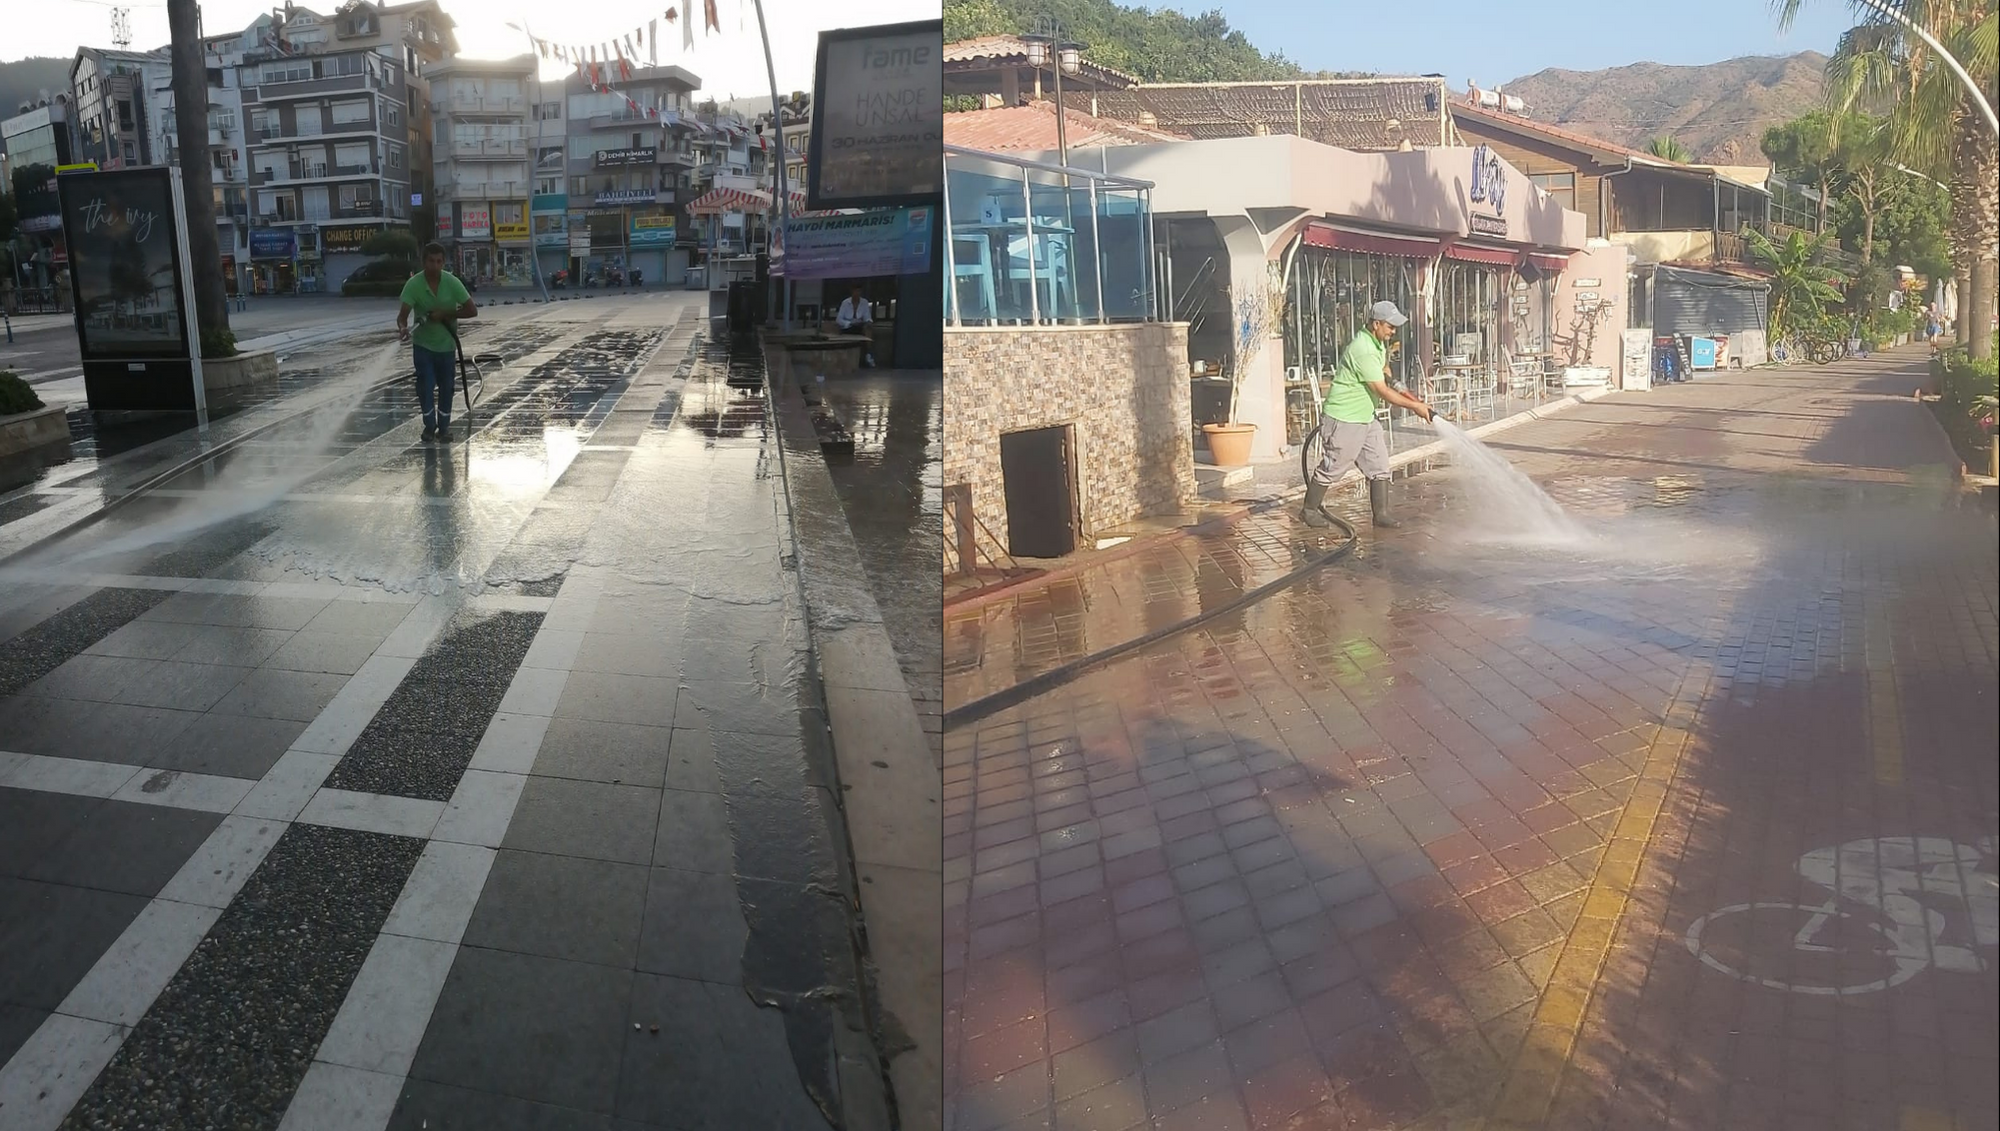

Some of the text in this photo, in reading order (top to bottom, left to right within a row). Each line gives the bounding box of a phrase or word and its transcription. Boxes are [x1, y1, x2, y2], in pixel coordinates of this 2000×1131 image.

[857, 87, 926, 109] HANDE
[831, 136, 855, 149] 30
[79, 198, 159, 243] the ivy
[787, 215, 894, 233] HAYDİ MARMARİS!
[326, 229, 353, 242] CHANGE
